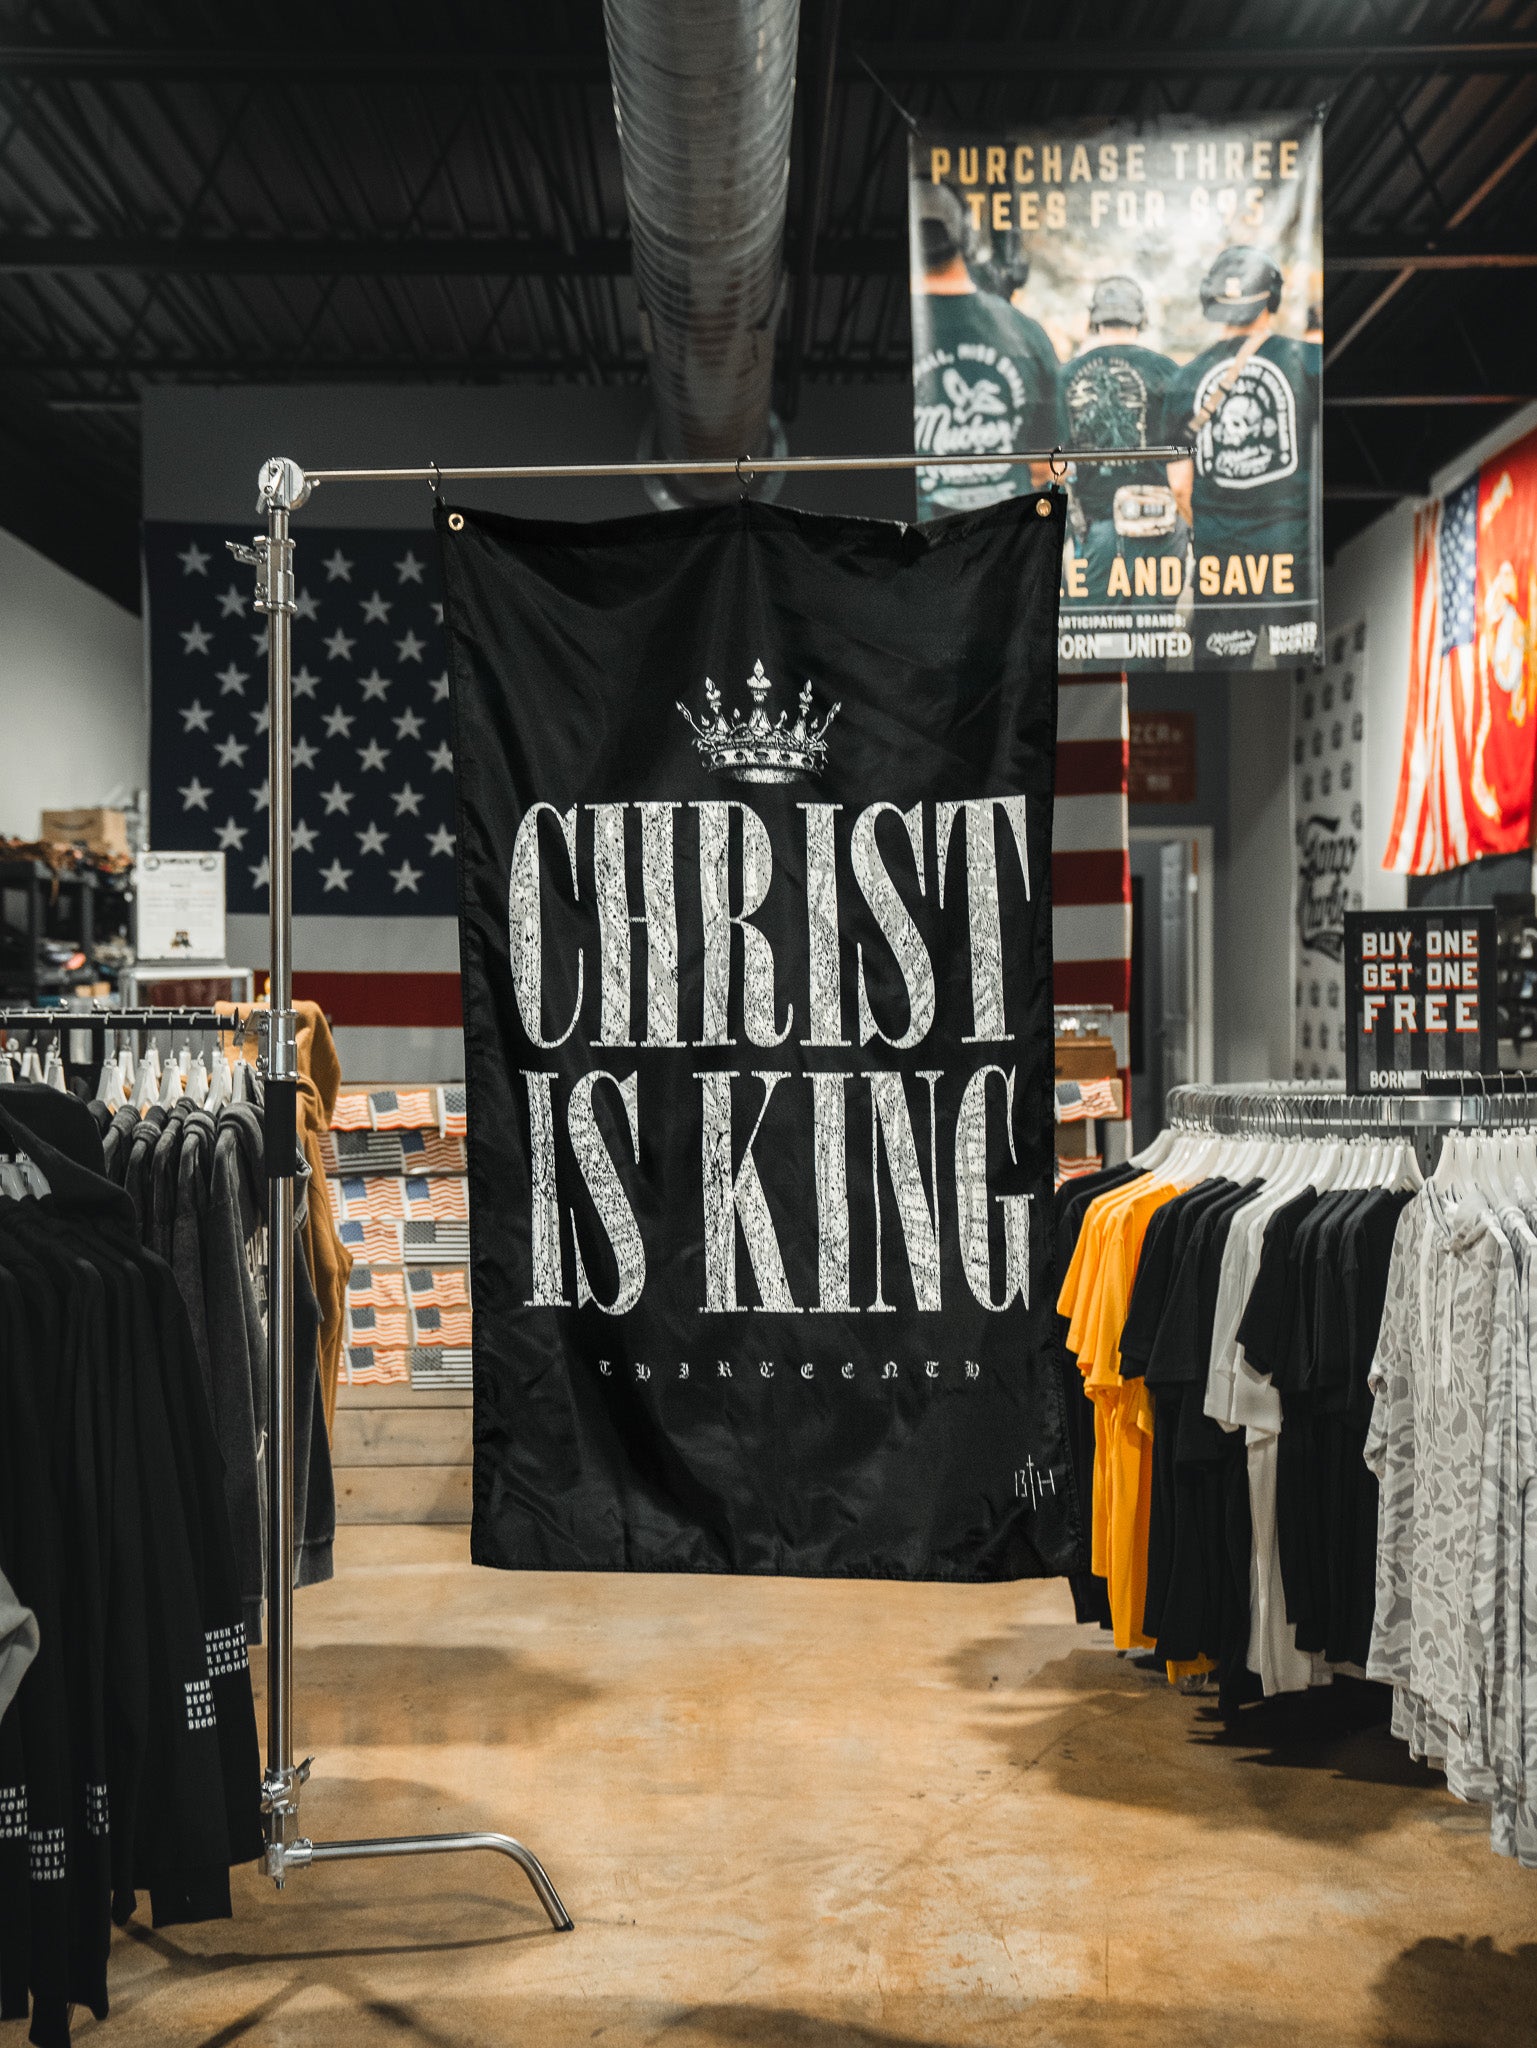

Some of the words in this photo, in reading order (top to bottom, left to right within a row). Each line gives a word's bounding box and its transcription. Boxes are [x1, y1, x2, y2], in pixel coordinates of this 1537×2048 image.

[931, 143, 1146, 185] PURCHASE
[1171, 141, 1299, 181] THREE
[965, 191, 1068, 231] TEES
[1090, 190, 1165, 230] FOR
[1107, 556, 1182, 597] AND
[1199, 554, 1295, 596] SAVE
[1127, 631, 1192, 658] UNITED
[508, 795, 1031, 1048] CHRIST
[1362, 930, 1413, 960] BUY
[1426, 929, 1479, 958] ONE
[1362, 962, 1414, 991] GET
[1426, 961, 1479, 990] ONE
[1363, 994, 1479, 1033] FREE
[1370, 1070, 1406, 1089] BORN
[519, 1069, 646, 1316] IS
[692, 1064, 1035, 1313] KING
[204, 1627, 231, 1641] WHEN
[184, 1679, 210, 1693] WHEN
[186, 1691, 214, 1706] BECO
[187, 1702, 216, 1718] REB
